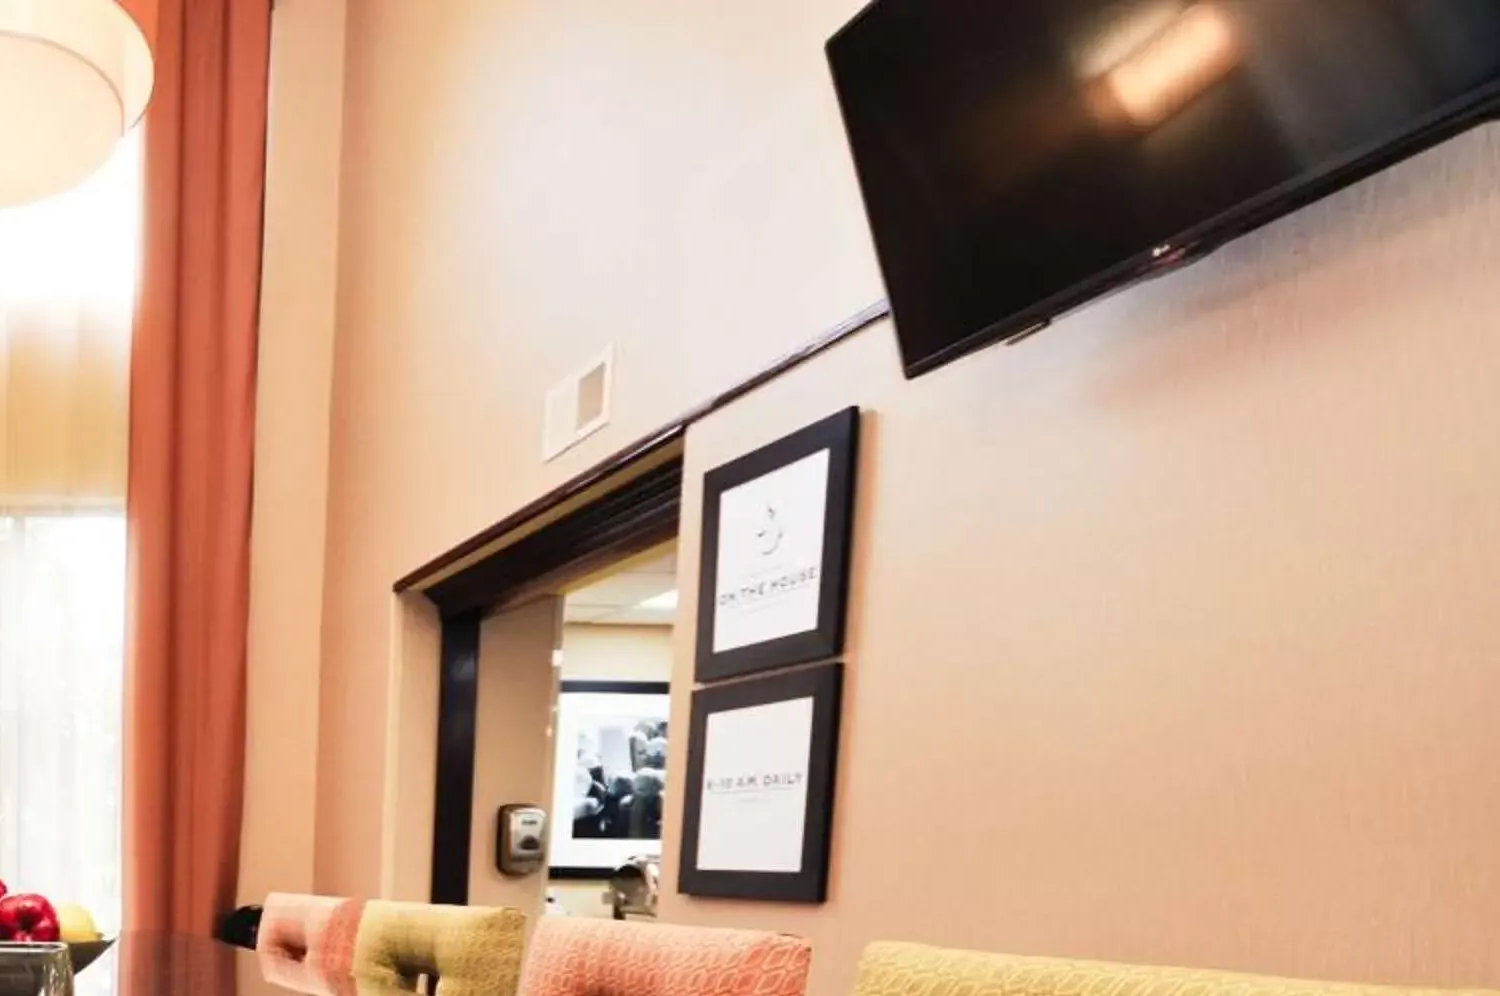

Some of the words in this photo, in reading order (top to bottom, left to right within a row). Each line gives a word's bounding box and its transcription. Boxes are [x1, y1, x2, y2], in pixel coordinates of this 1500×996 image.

[740, 580, 766, 597] THE
[770, 566, 817, 590] HOUSE
[735, 774, 758, 788] AM
[763, 771, 803, 786] DAILY
